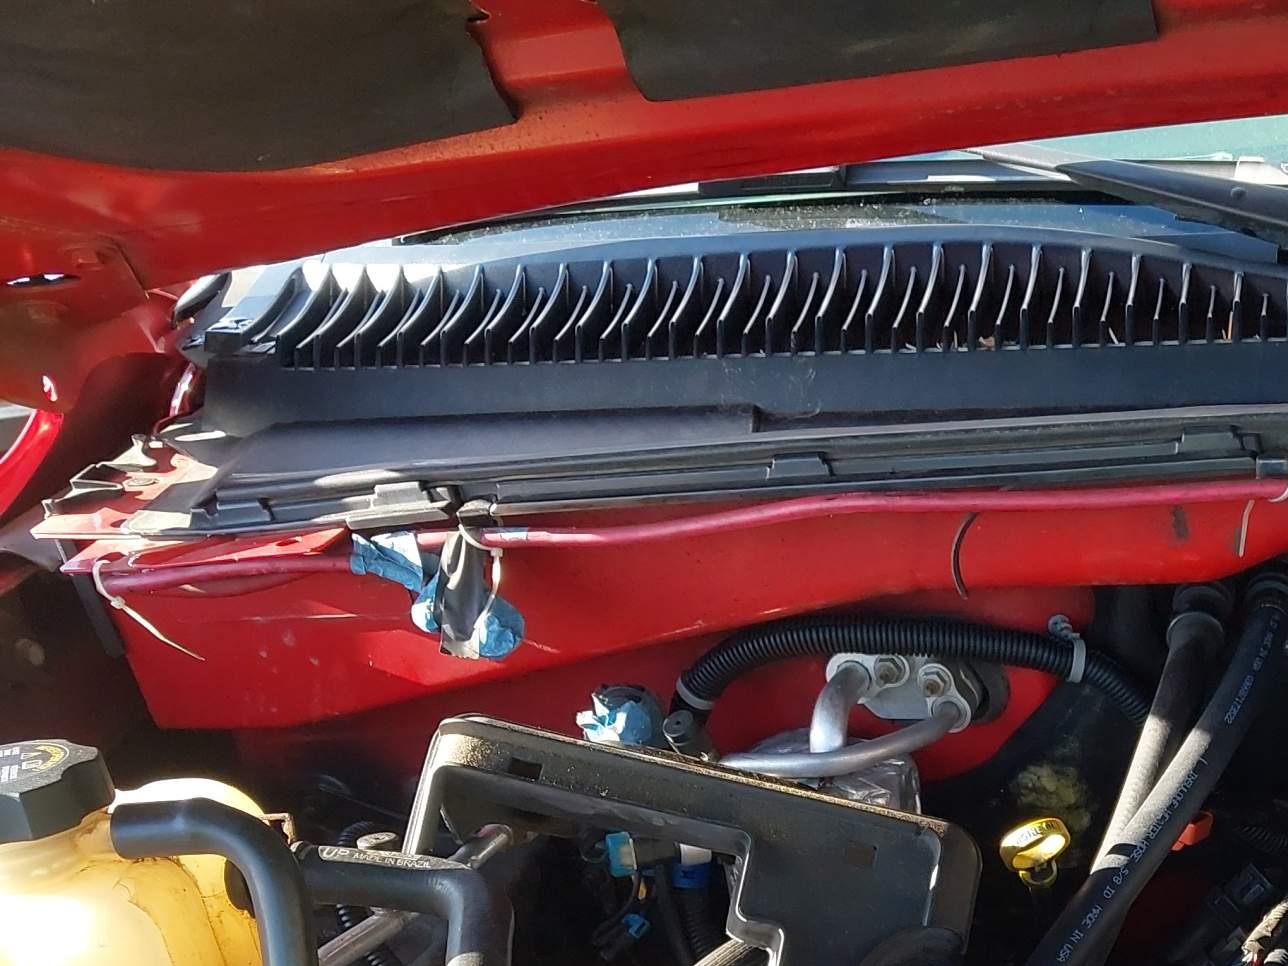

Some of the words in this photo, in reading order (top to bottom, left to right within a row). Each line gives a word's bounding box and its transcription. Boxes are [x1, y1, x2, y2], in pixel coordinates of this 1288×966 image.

[352, 853, 382, 863] MADE
[384, 858, 396, 866] IN
[396, 859, 432, 869] BRAZIL
[1130, 840, 1150, 863] HOSE
[1113, 864, 1129, 886] 5/8
[1103, 884, 1117, 899] ID
[1081, 904, 1103, 929] MADE
[1070, 929, 1084, 943] IN
[1056, 943, 1073, 962] USA
